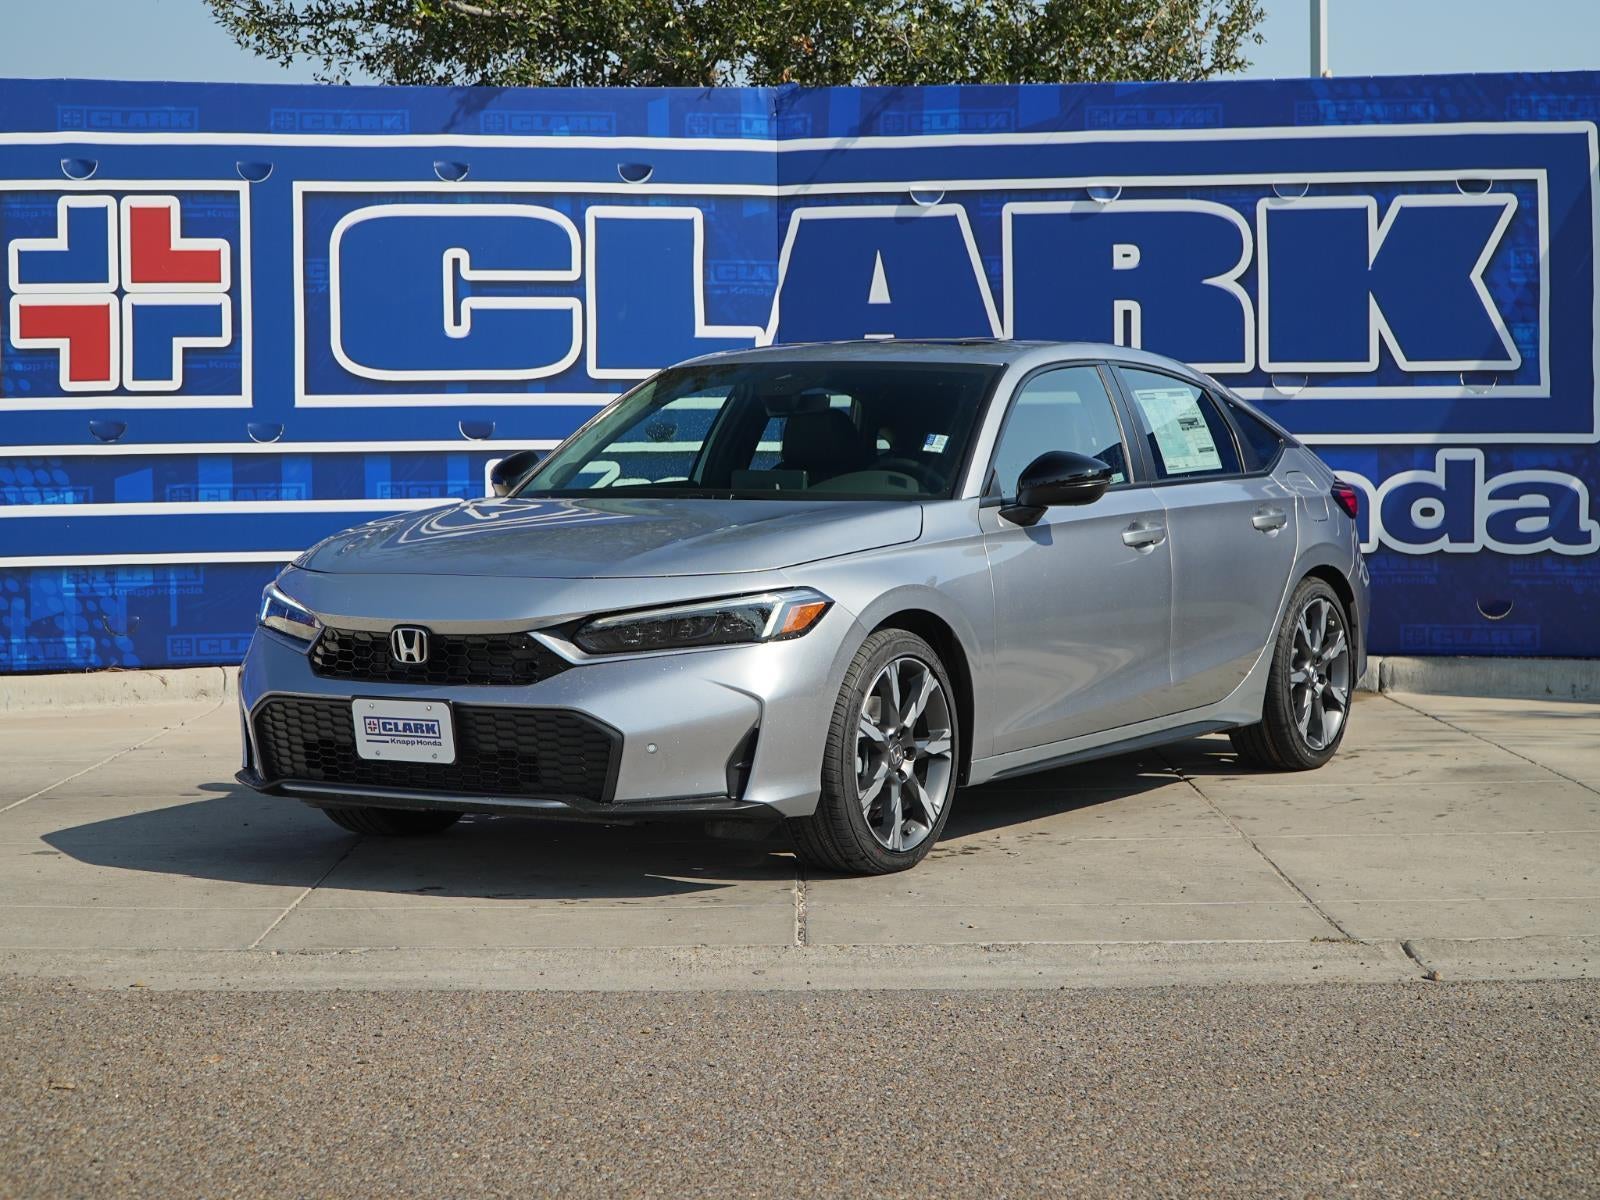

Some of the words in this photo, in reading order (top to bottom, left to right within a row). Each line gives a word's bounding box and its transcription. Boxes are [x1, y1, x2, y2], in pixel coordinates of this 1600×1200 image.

[90, 111, 192, 128] CLARK
[302, 113, 402, 130] CLARK
[511, 115, 610, 132] CLARK
[911, 112, 1009, 130] CLARK
[1113, 107, 1217, 125] CLARK
[330, 194, 1521, 381] CLARK
[381, 720, 437, 736] CLARK
[390, 737, 416, 747] Knapp
[416, 738, 443, 747] Honda
